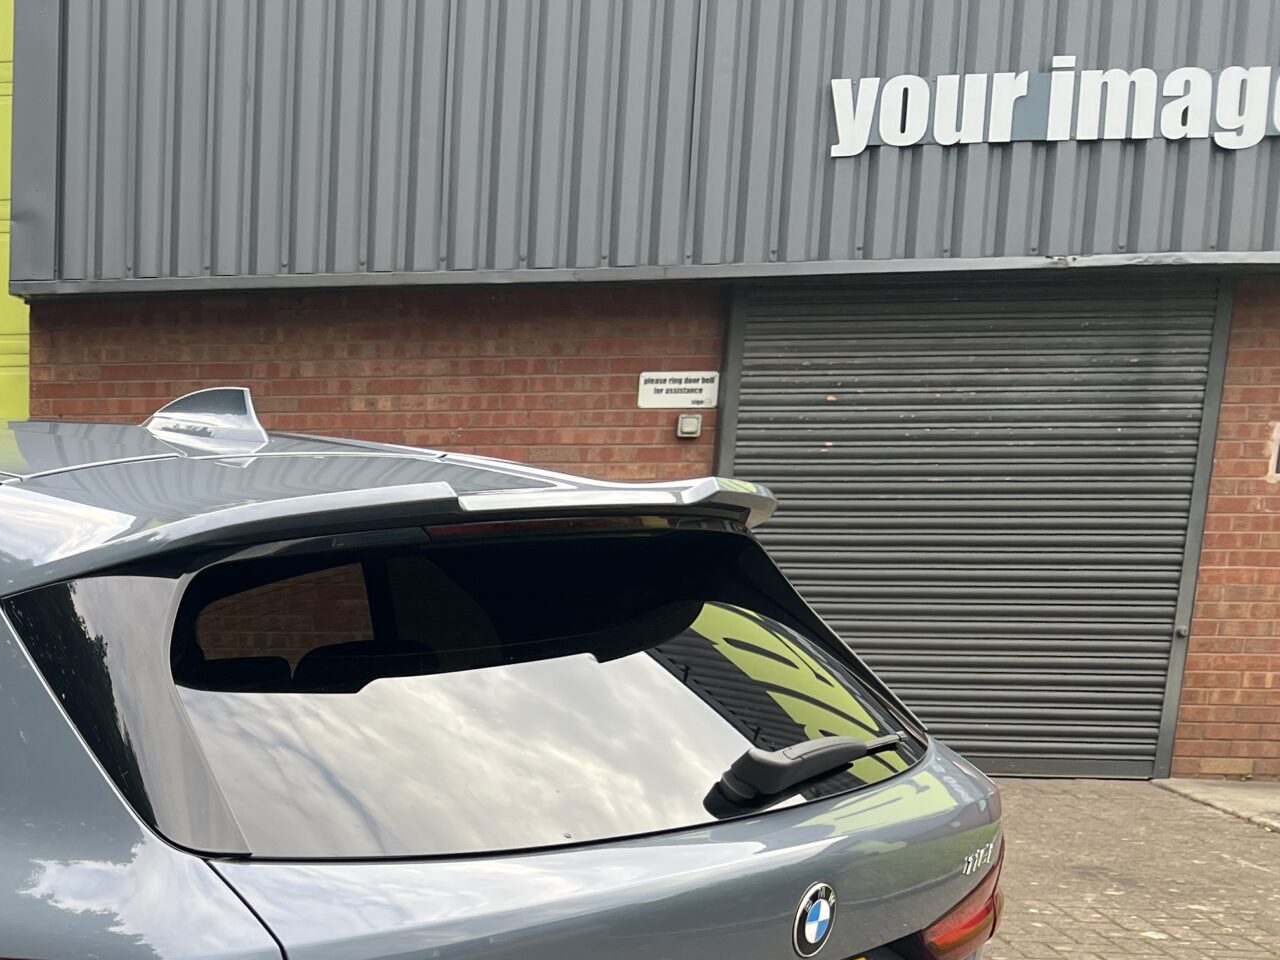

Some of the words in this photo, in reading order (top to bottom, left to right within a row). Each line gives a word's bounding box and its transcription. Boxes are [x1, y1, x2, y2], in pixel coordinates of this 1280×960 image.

[830, 70, 1029, 158] your
[1046, 55, 1280, 150] imag
[668, 377, 682, 385] ring
[684, 376, 700, 384] door
[701, 376, 715, 384] bell
